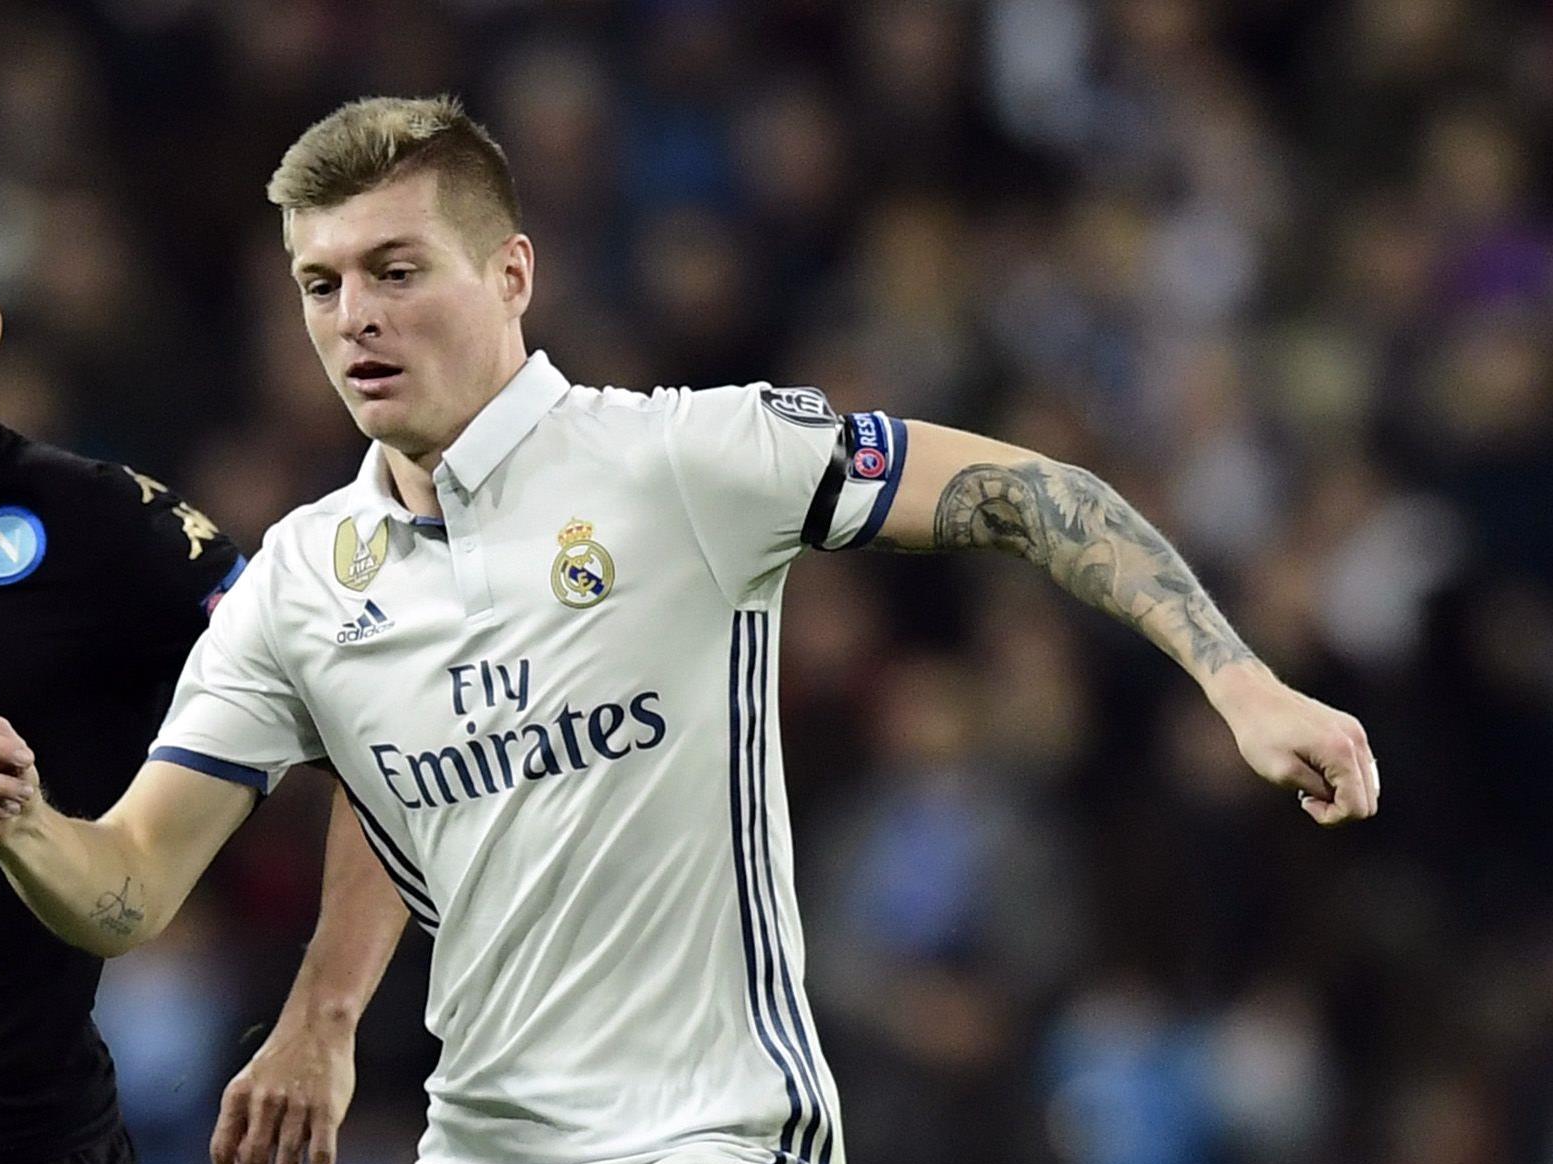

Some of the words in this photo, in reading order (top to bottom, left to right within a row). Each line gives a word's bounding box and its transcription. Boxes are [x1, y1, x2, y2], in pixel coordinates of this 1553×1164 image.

[336, 620, 396, 644] adidas
[448, 659, 530, 715] Fly
[371, 691, 666, 810] Emirates
